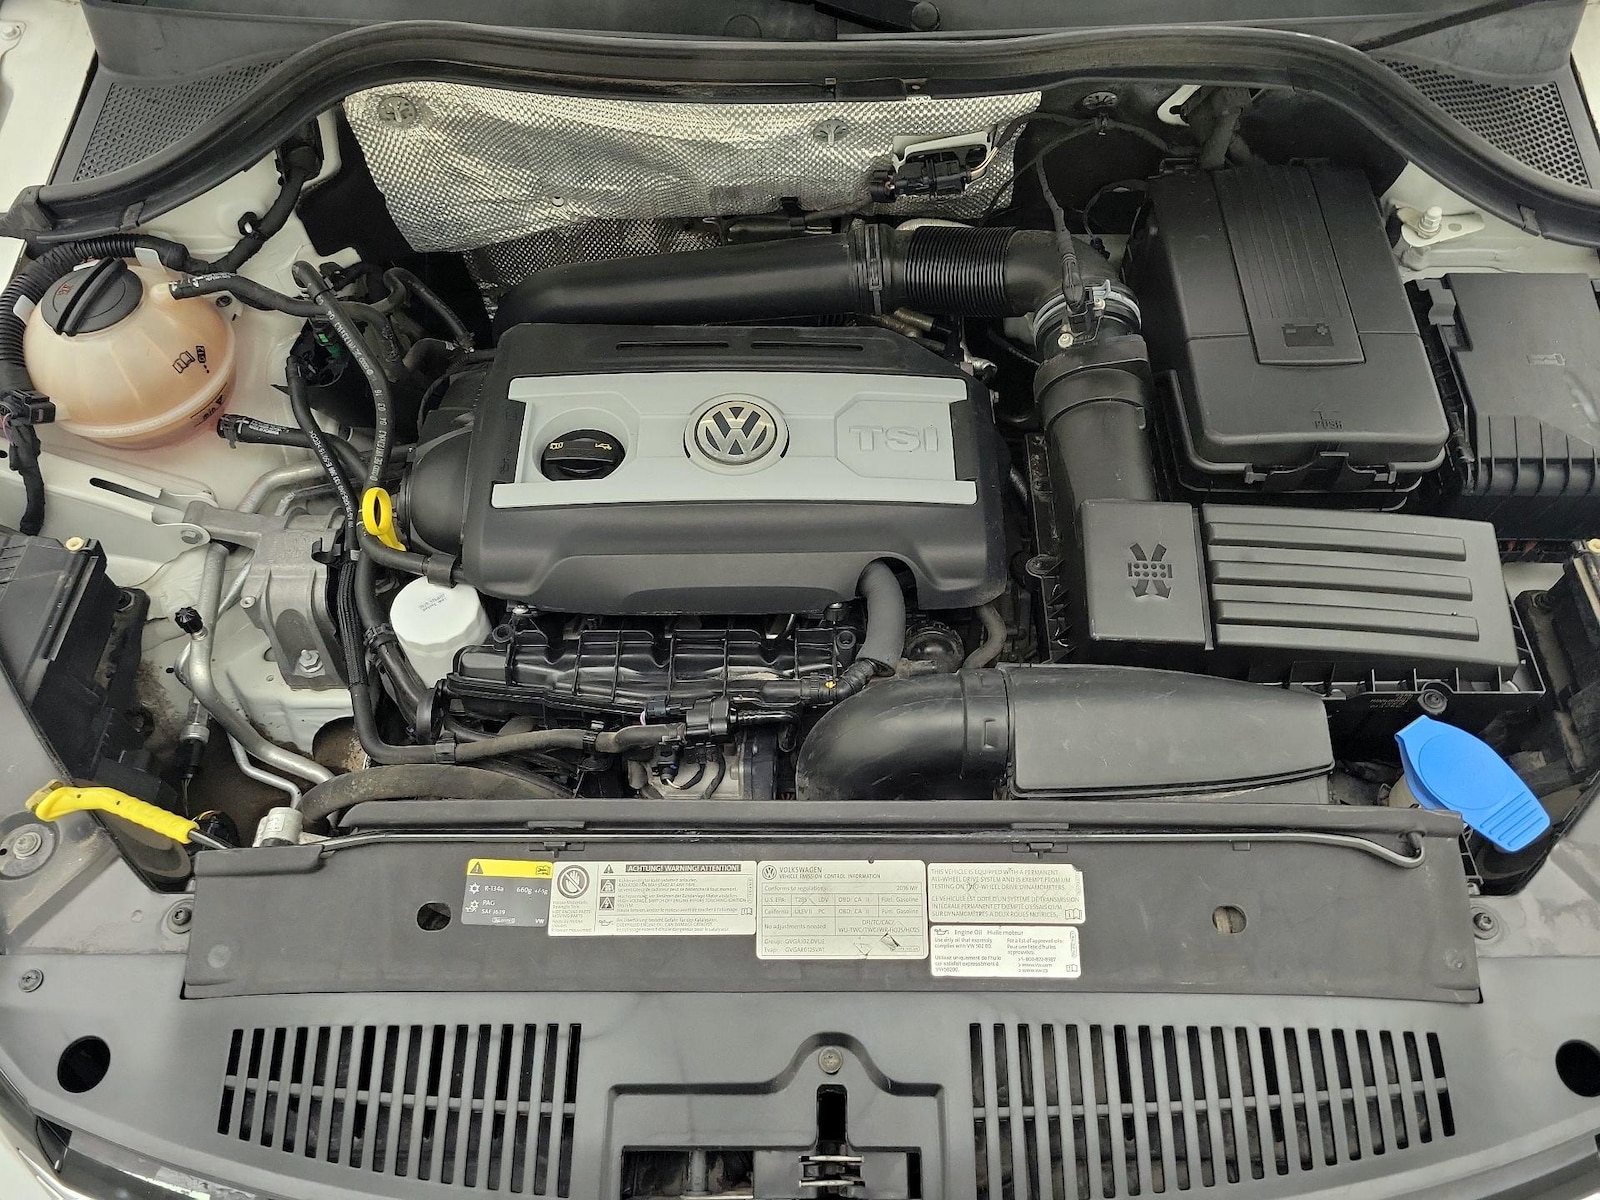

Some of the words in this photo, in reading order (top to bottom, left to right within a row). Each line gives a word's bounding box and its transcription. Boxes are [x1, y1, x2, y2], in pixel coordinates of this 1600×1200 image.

[203, 407, 216, 420] min
[1314, 420, 1342, 430] PUSH
[849, 426, 938, 452] TSI
[516, 886, 532, 894] 660g
